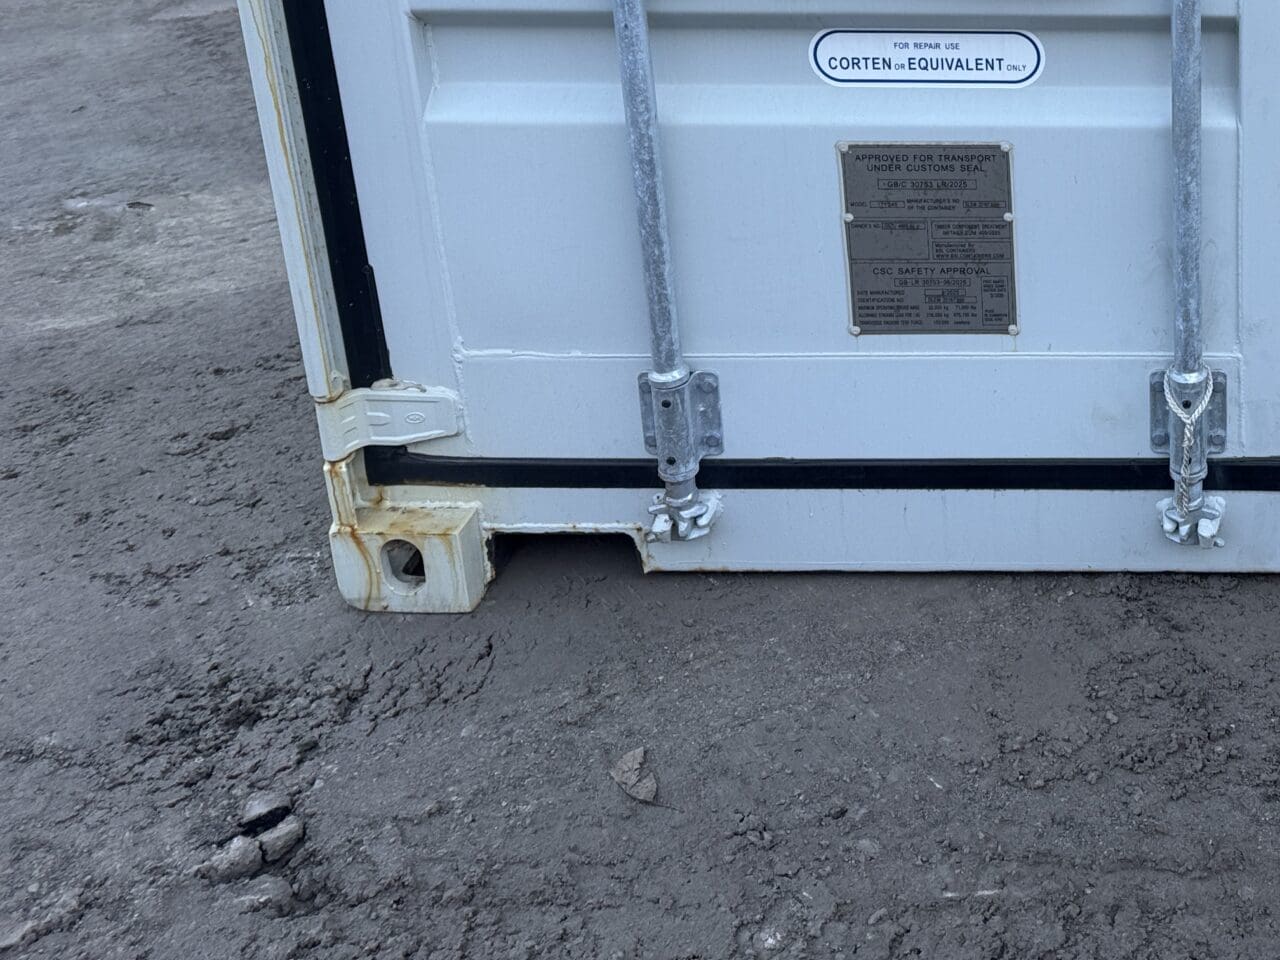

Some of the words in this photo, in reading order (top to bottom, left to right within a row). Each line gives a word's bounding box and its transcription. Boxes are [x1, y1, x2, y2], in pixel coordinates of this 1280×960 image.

[893, 42, 910, 50] FOR
[913, 42, 941, 50] REPAIR
[944, 43, 961, 51] USE
[828, 56, 892, 71] CORTEN
[894, 63, 906, 71] OR
[908, 57, 1005, 72] EQUIVALENT
[1006, 64, 1027, 72] ONLY
[855, 154, 909, 163] APPROVED
[913, 154, 934, 163] FOR
[938, 154, 997, 163] TRANSPORT
[867, 163, 902, 172] UNDER
[906, 163, 956, 172] CUSTOMS
[960, 163, 985, 172] SEAL
[872, 268, 894, 276] CSC
[898, 268, 936, 276] SAFETY
[940, 268, 992, 276] APPROVAL
